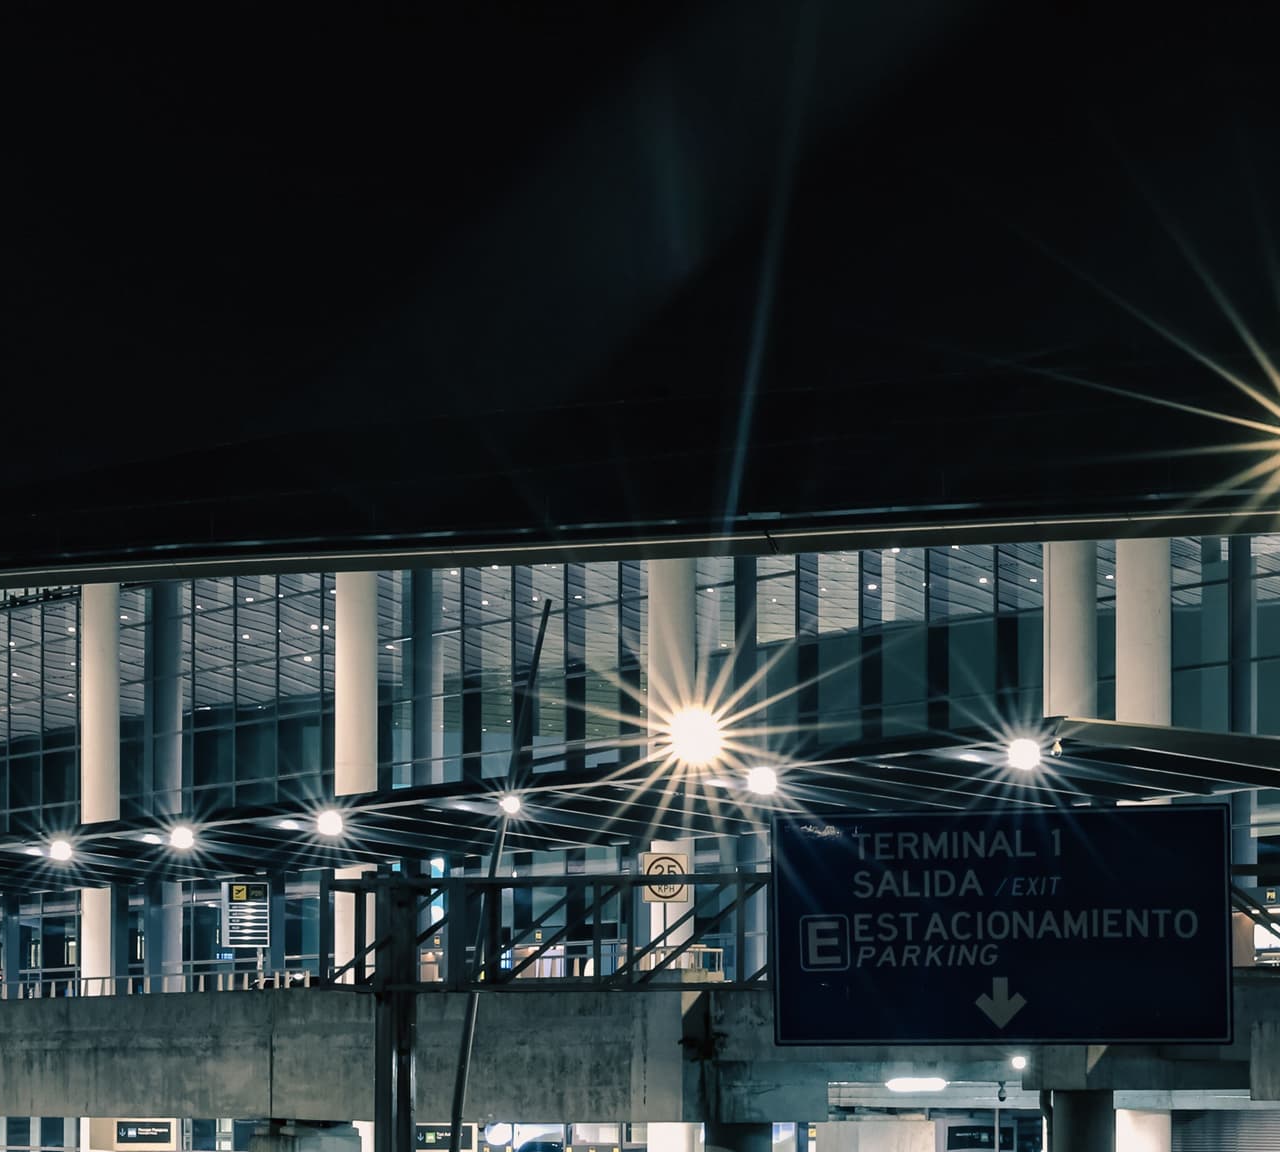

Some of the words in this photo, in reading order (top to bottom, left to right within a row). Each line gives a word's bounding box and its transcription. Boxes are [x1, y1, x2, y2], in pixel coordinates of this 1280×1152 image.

[853, 829, 1037, 860] TERMINAL
[1051, 829, 1061, 857] 1
[853, 869, 984, 899] SALIDA
[853, 909, 1199, 942] ESTACIONAMIENTO
[808, 921, 842, 965] E
[856, 943, 1000, 968] PARKING
